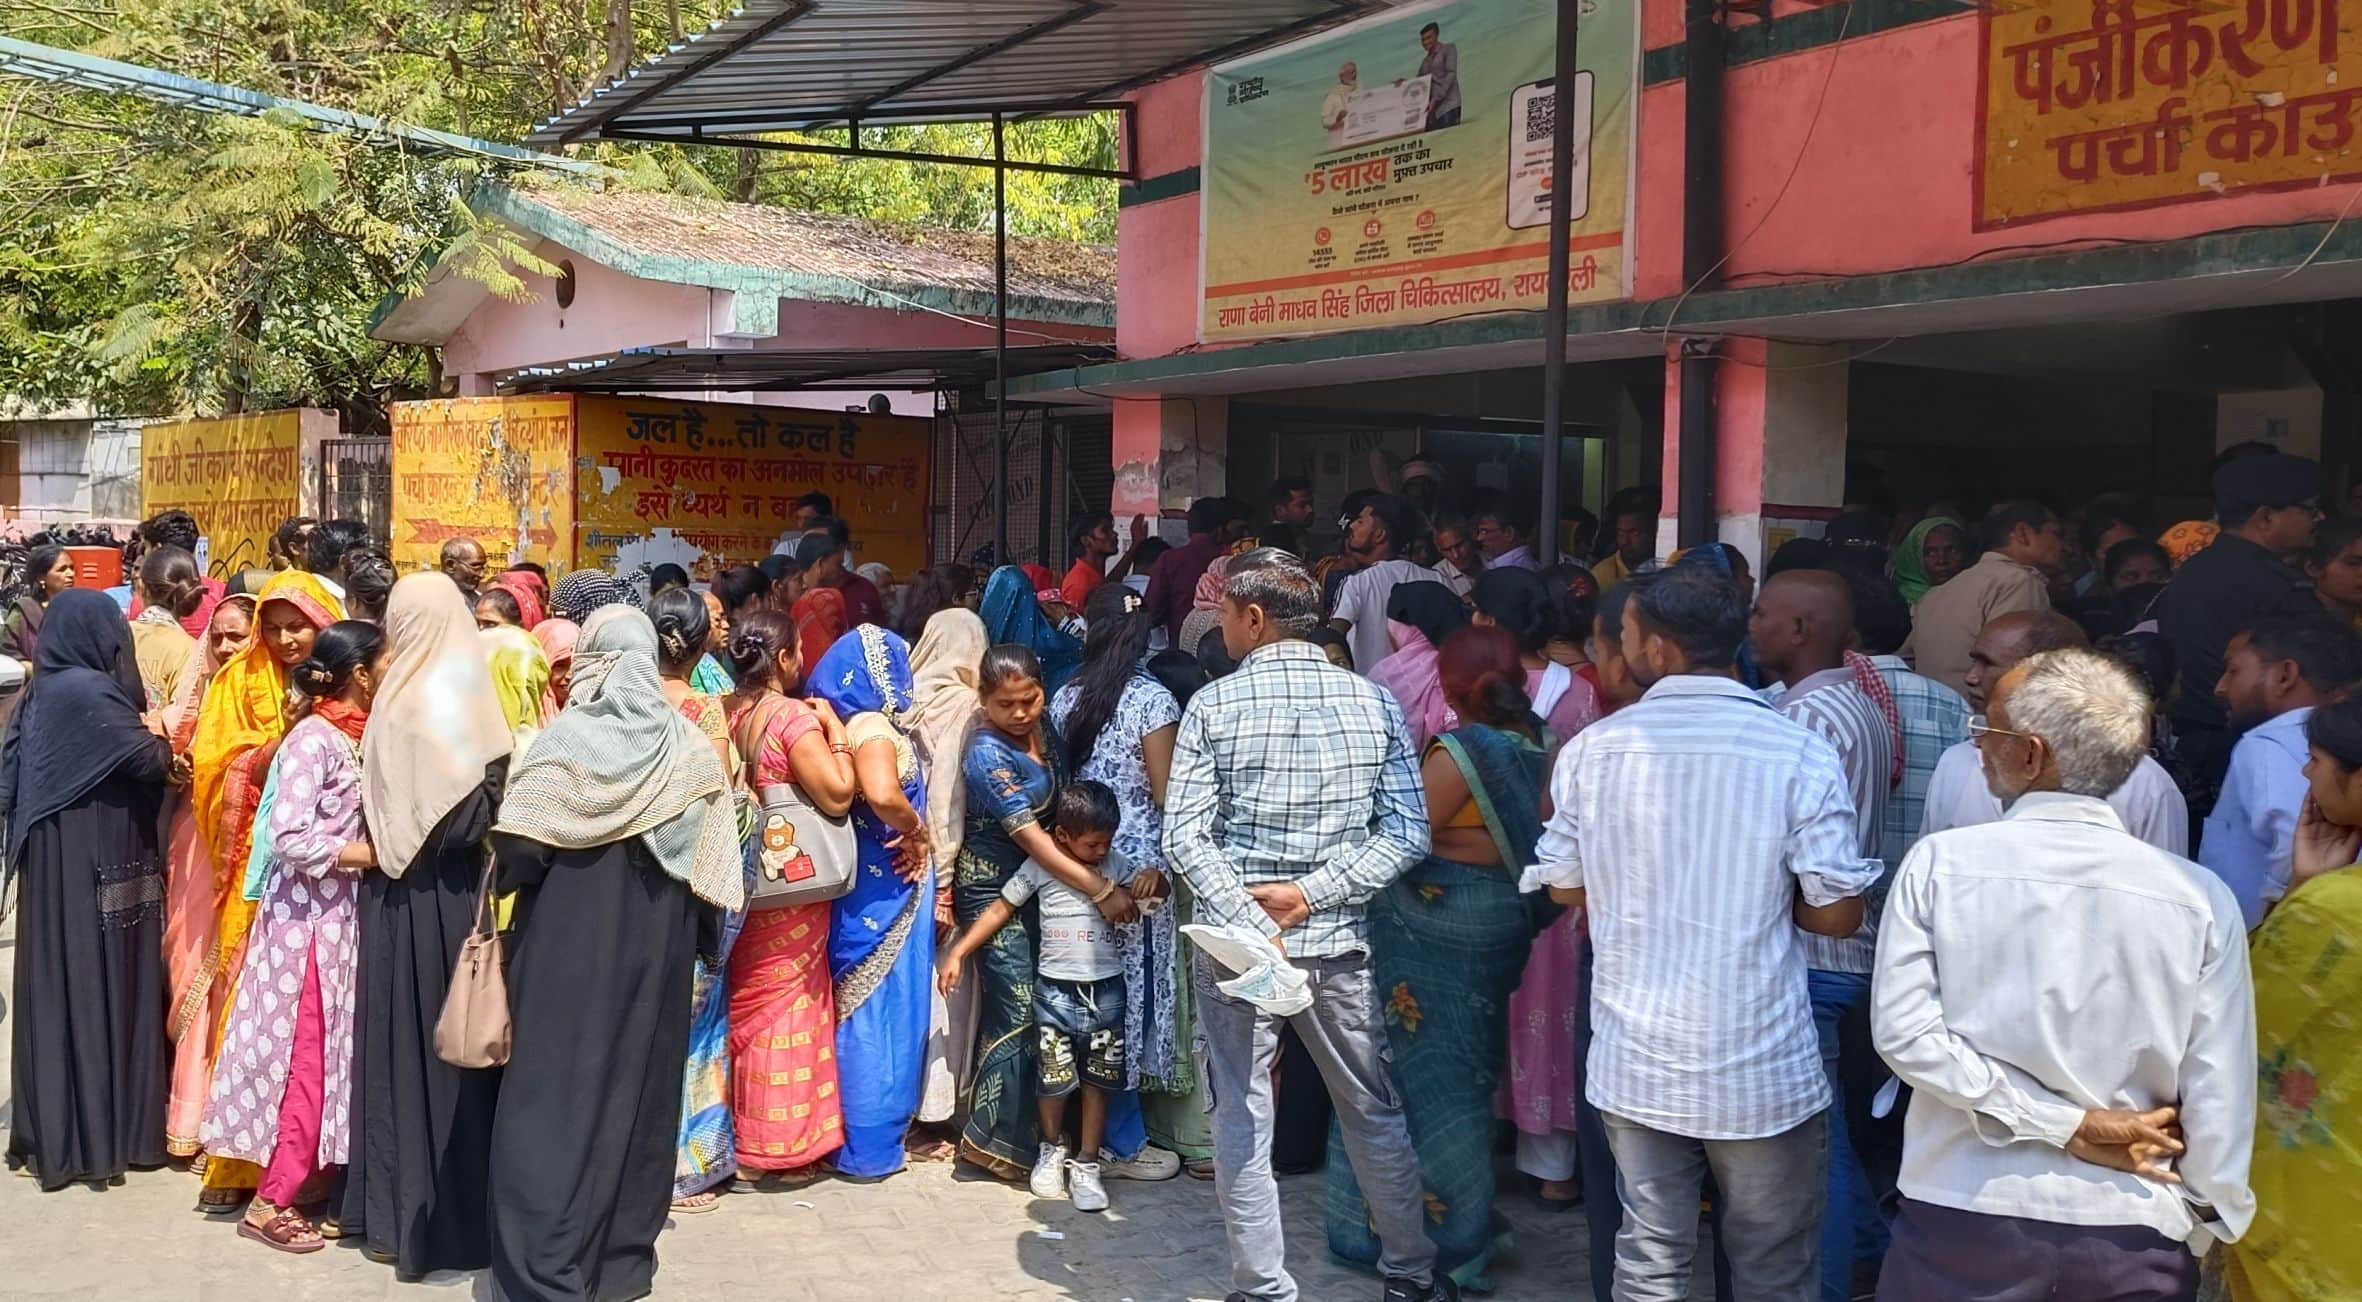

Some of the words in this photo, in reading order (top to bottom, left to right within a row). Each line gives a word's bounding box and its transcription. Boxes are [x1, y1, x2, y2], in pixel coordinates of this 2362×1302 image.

[2002, 0, 2339, 115] पंजीकरण
[2045, 97, 2192, 183] पर्चा
[2203, 86, 2362, 163] काउ
[1328, 157, 1390, 192] लाख
[1393, 152, 1414, 166] तक
[1415, 148, 1431, 160] का
[1420, 157, 1454, 174] उपचार
[1218, 307, 1246, 328] राणा
[1249, 296, 1275, 325] बेनी
[1279, 299, 1318, 322] माधव
[1322, 289, 1351, 318] सिंह
[1355, 284, 1396, 315] जिला
[625, 410, 681, 443] जल
[776, 422, 834, 452] कल
[836, 416, 861, 460] है
[148, 439, 183, 486] गांधी
[184, 436, 204, 486] जी
[206, 450, 227, 485] का
[602, 444, 656, 481] पानी
[656, 453, 717, 487] कुदरत
[718, 456, 749, 482] का
[751, 453, 828, 485] अनमोल
[634, 484, 673, 522] इसे
[742, 494, 762, 520] न
